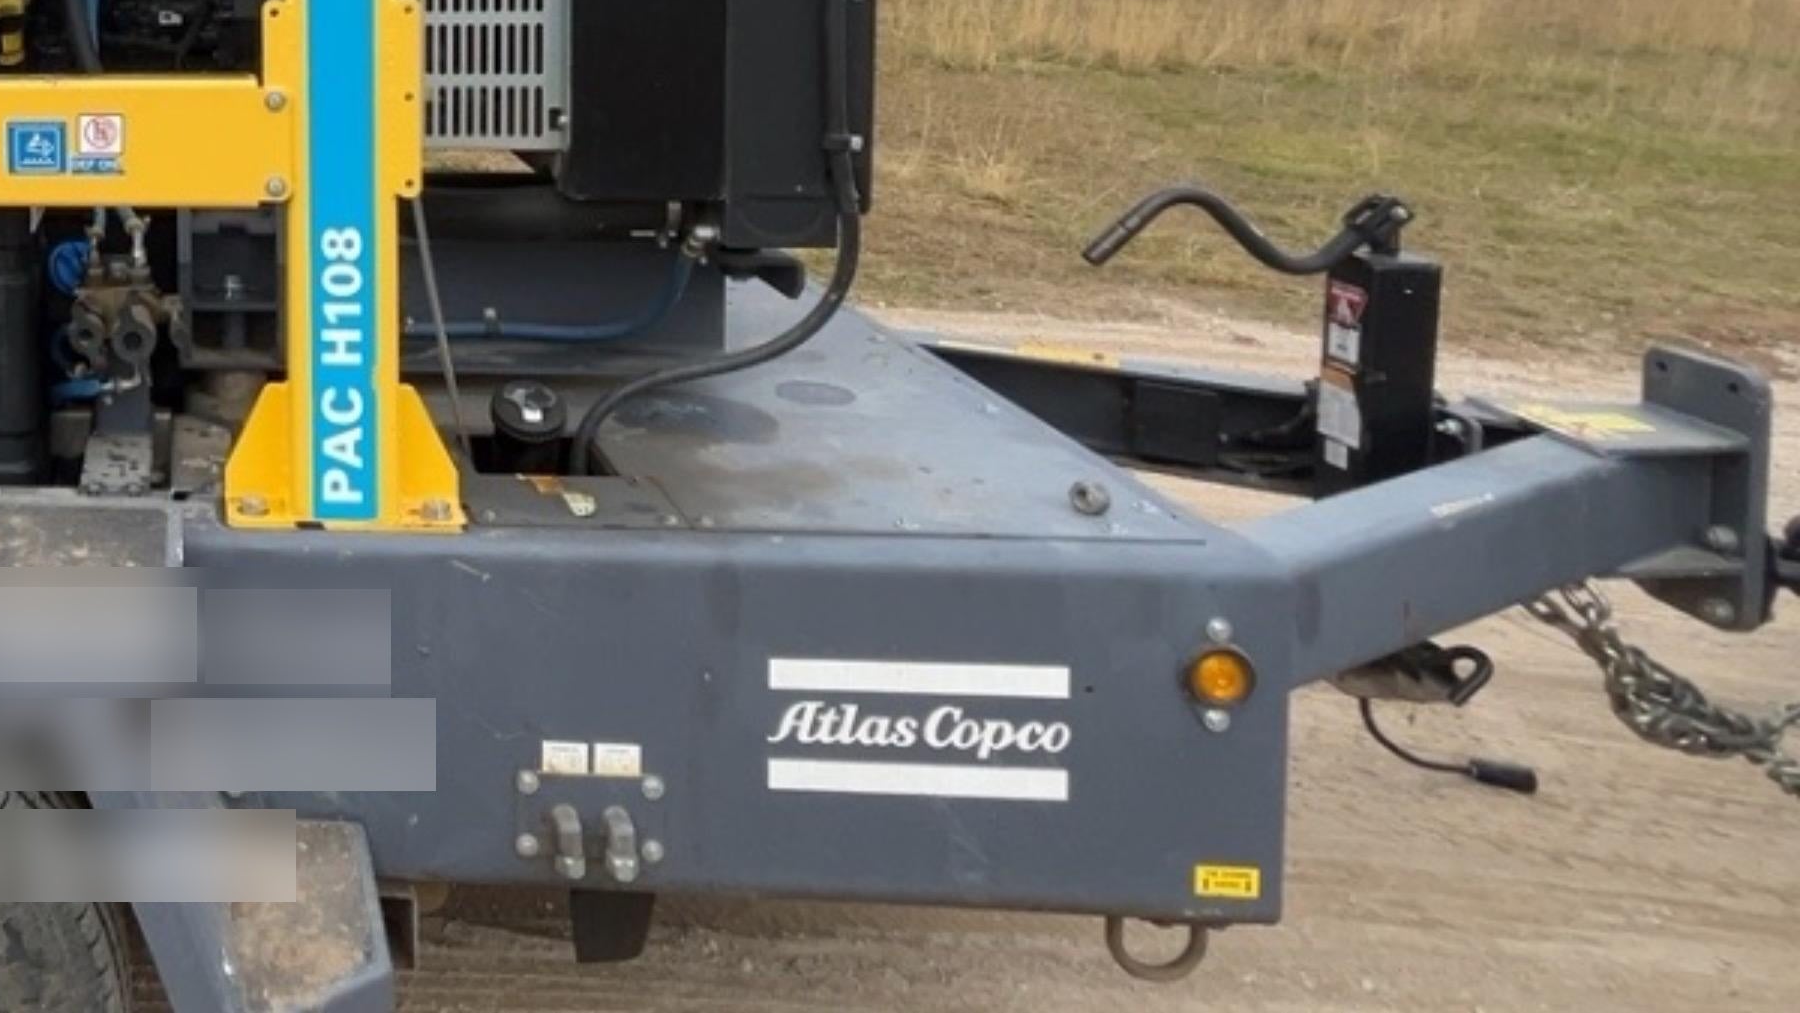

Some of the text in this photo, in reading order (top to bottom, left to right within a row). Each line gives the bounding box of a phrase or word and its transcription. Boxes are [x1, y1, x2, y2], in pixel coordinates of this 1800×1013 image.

[321, 226, 364, 503] PAC H108
[767, 700, 1071, 759] Atlas Copco
